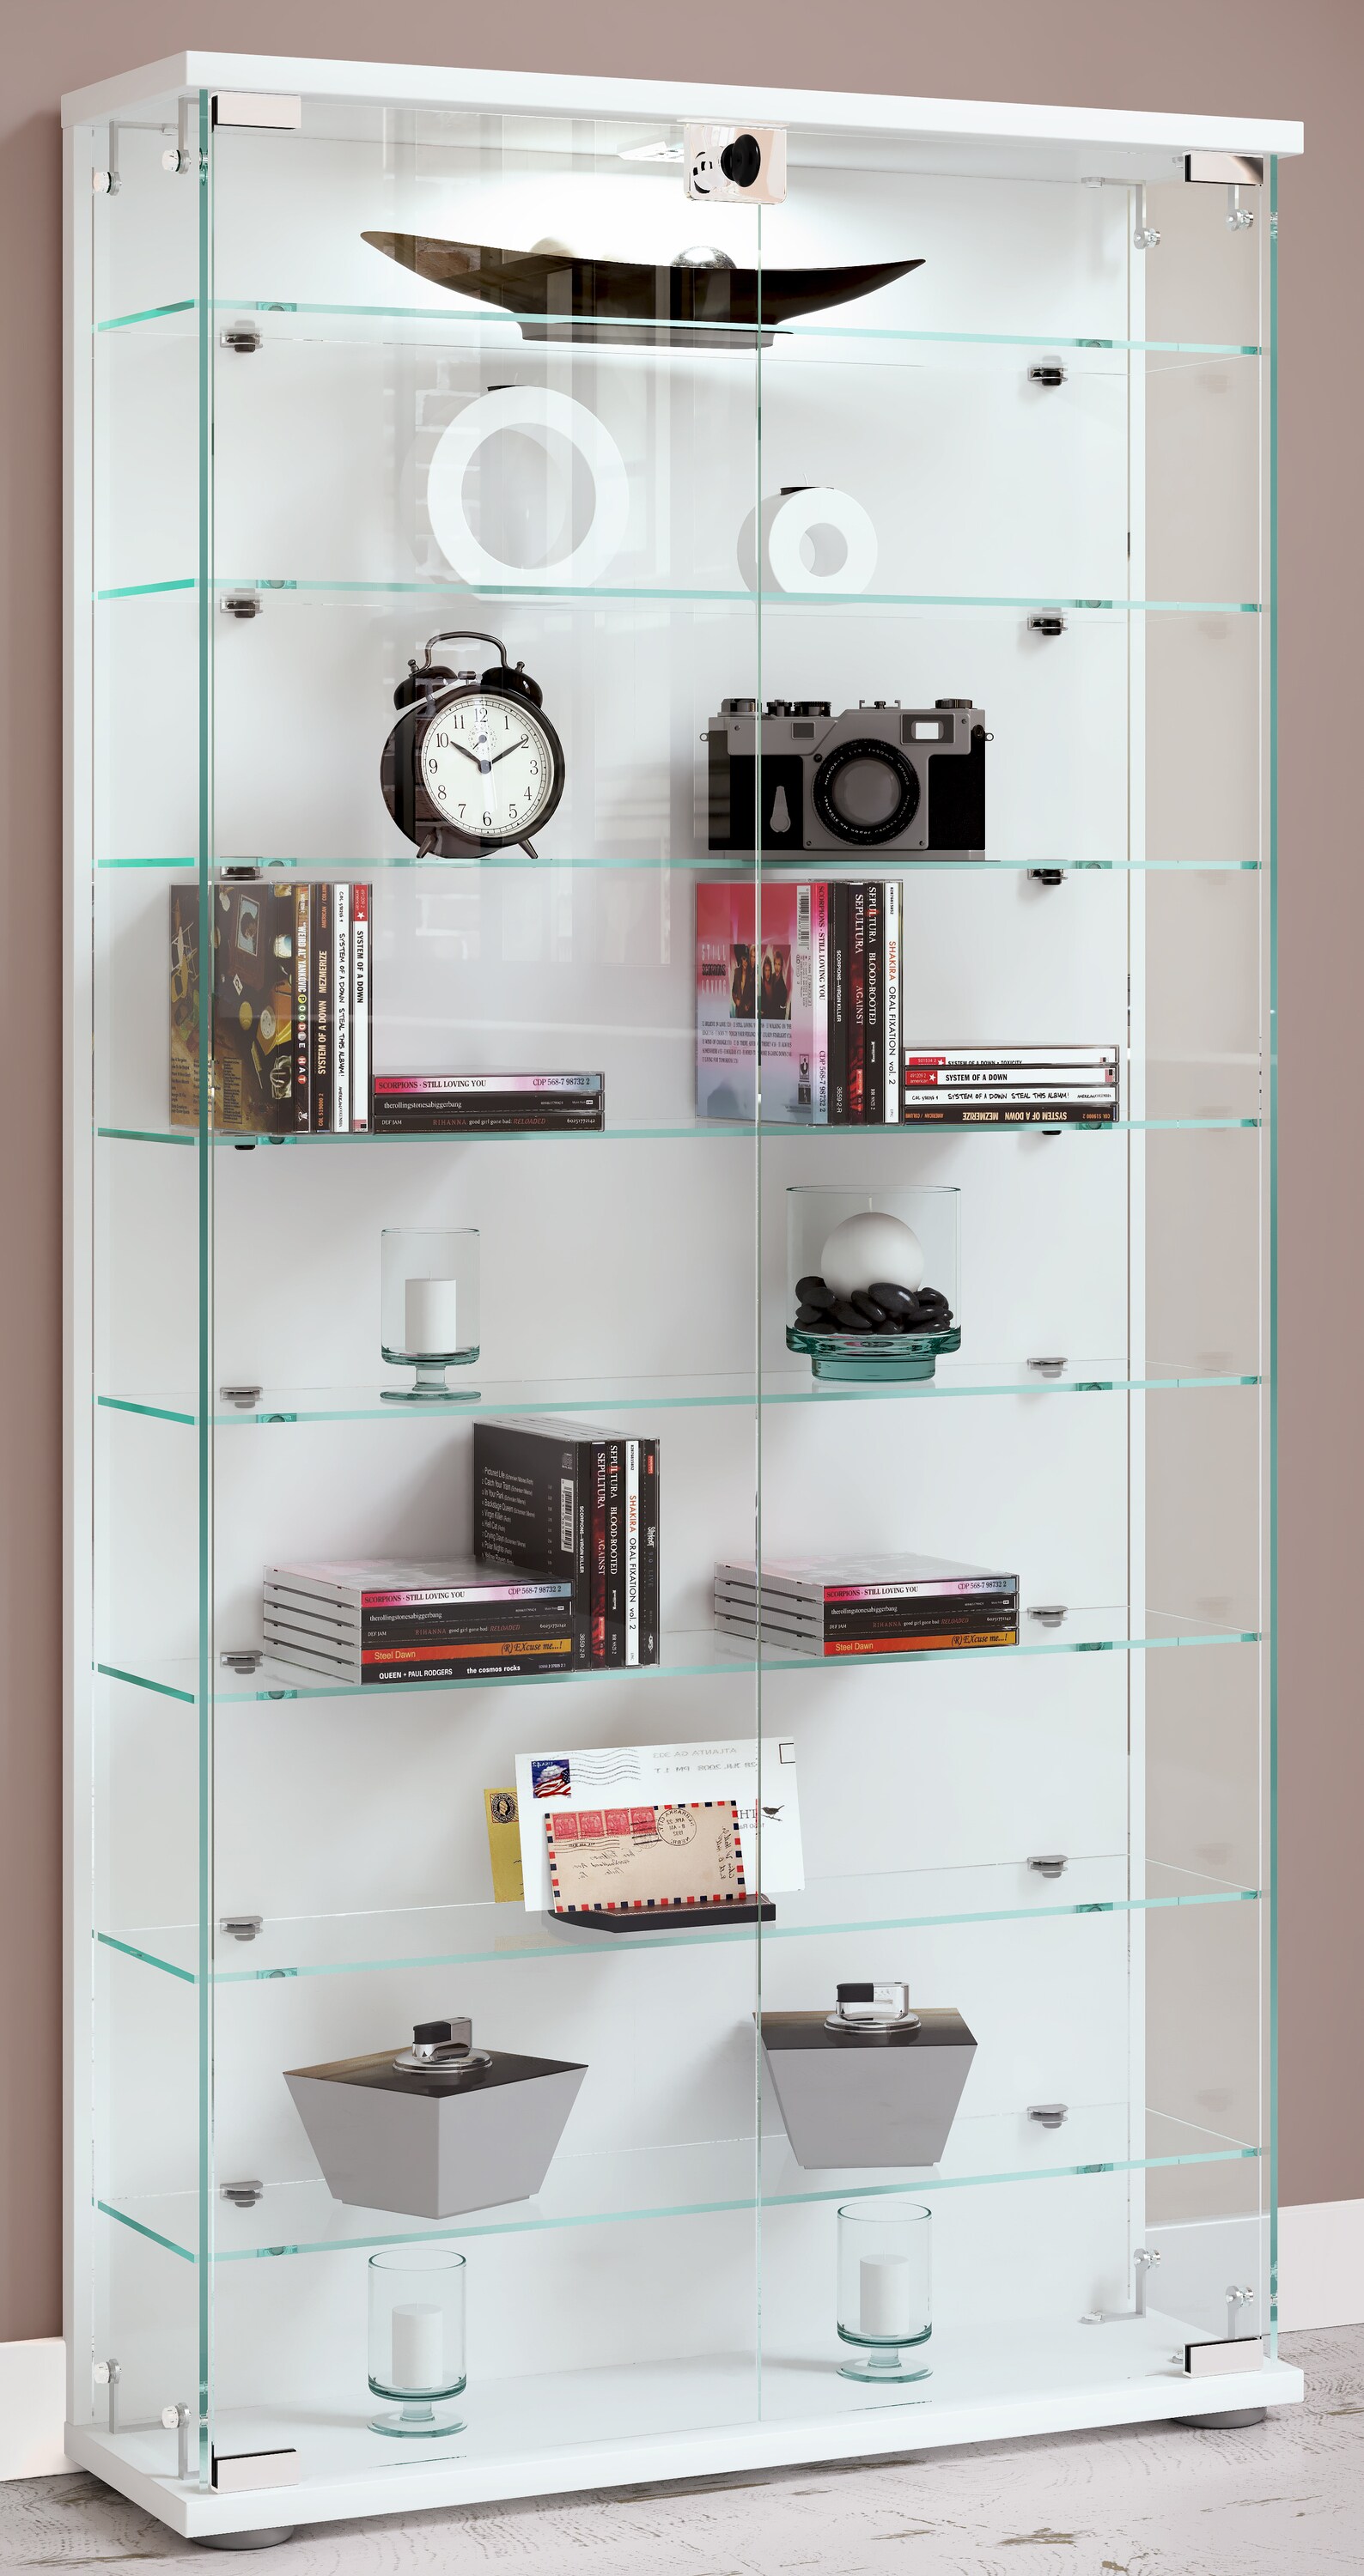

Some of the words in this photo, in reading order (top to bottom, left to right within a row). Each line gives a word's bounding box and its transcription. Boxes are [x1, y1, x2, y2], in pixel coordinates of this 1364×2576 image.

[454, 714, 465, 729] 11
[474, 708, 488, 722] 12
[505, 715, 509, 730] 1
[436, 732, 449, 748] 10
[521, 734, 529, 748] 2
[429, 759, 438, 774] 9
[530, 760, 539, 775] 3
[438, 785, 447, 799] 8
[524, 787, 532, 800] 4
[458, 804, 466, 818] 7
[483, 811, 492, 826] 6
[508, 804, 517, 818] 5
[868, 886, 877, 943] SEPULTURA
[855, 894, 863, 954] SEPULTURA
[339, 965, 345, 974] OF
[357, 962, 363, 971] OF
[298, 959, 307, 993] YANKOVIC
[318, 1033, 326, 1042] OF
[318, 1044, 326, 1074] SYSTEM
[298, 1056, 307, 1084] HAT
[962, 1112, 999, 1121] MEZMERIZE
[835, 1643, 853, 1651] Steel
[951, 1635, 963, 1646] (R)
[374, 1651, 393, 1660] Steel
[501, 1643, 514, 1655] (R)
